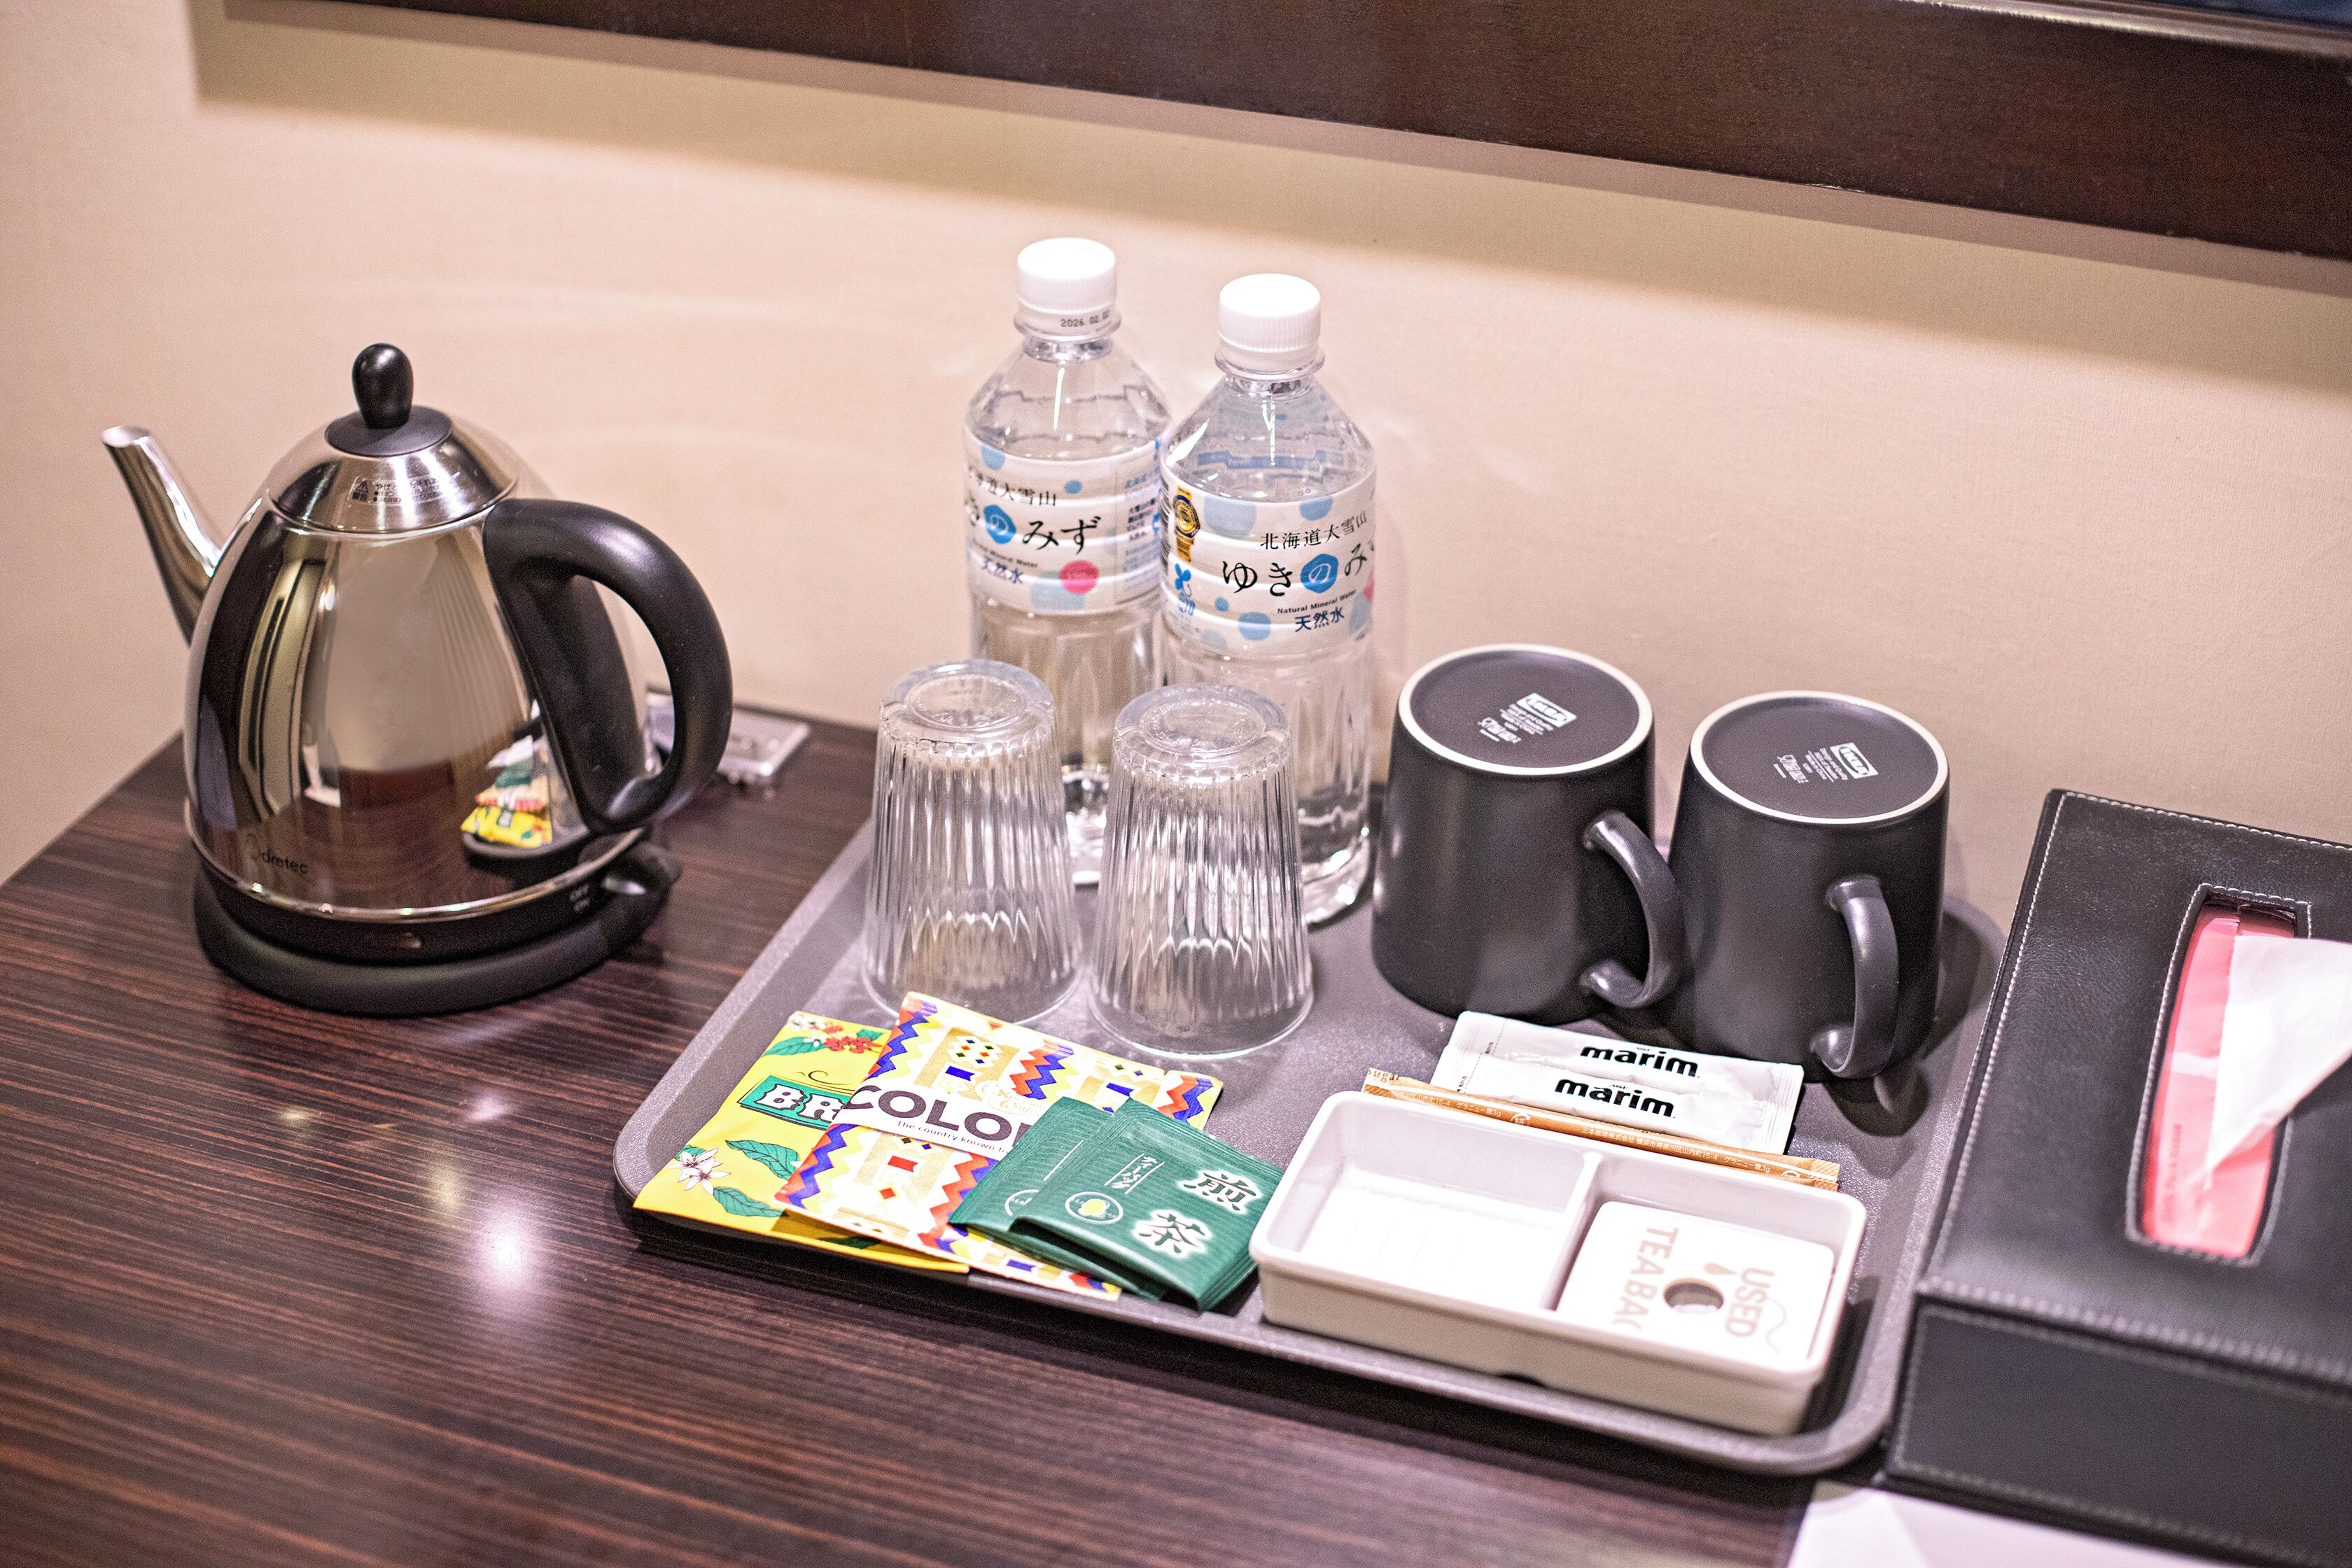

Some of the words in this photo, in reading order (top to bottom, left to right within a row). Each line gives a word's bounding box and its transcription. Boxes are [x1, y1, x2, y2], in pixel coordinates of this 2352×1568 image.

[1260, 510, 1367, 550] 北海道大雪山
[1278, 606, 1308, 615] Natural
[1310, 597, 1338, 610] Mineral
[1339, 589, 1357, 602] Water
[1295, 606, 1345, 632] 天然水
[1580, 1046, 1698, 1077] marim
[1555, 1079, 1674, 1118] marim
[897, 1121, 915, 1129] The
[918, 1126, 958, 1141] country
[961, 1136, 995, 1152] known
[1629, 1226, 1680, 1275] TEA
[1725, 1268, 1776, 1338] USED
